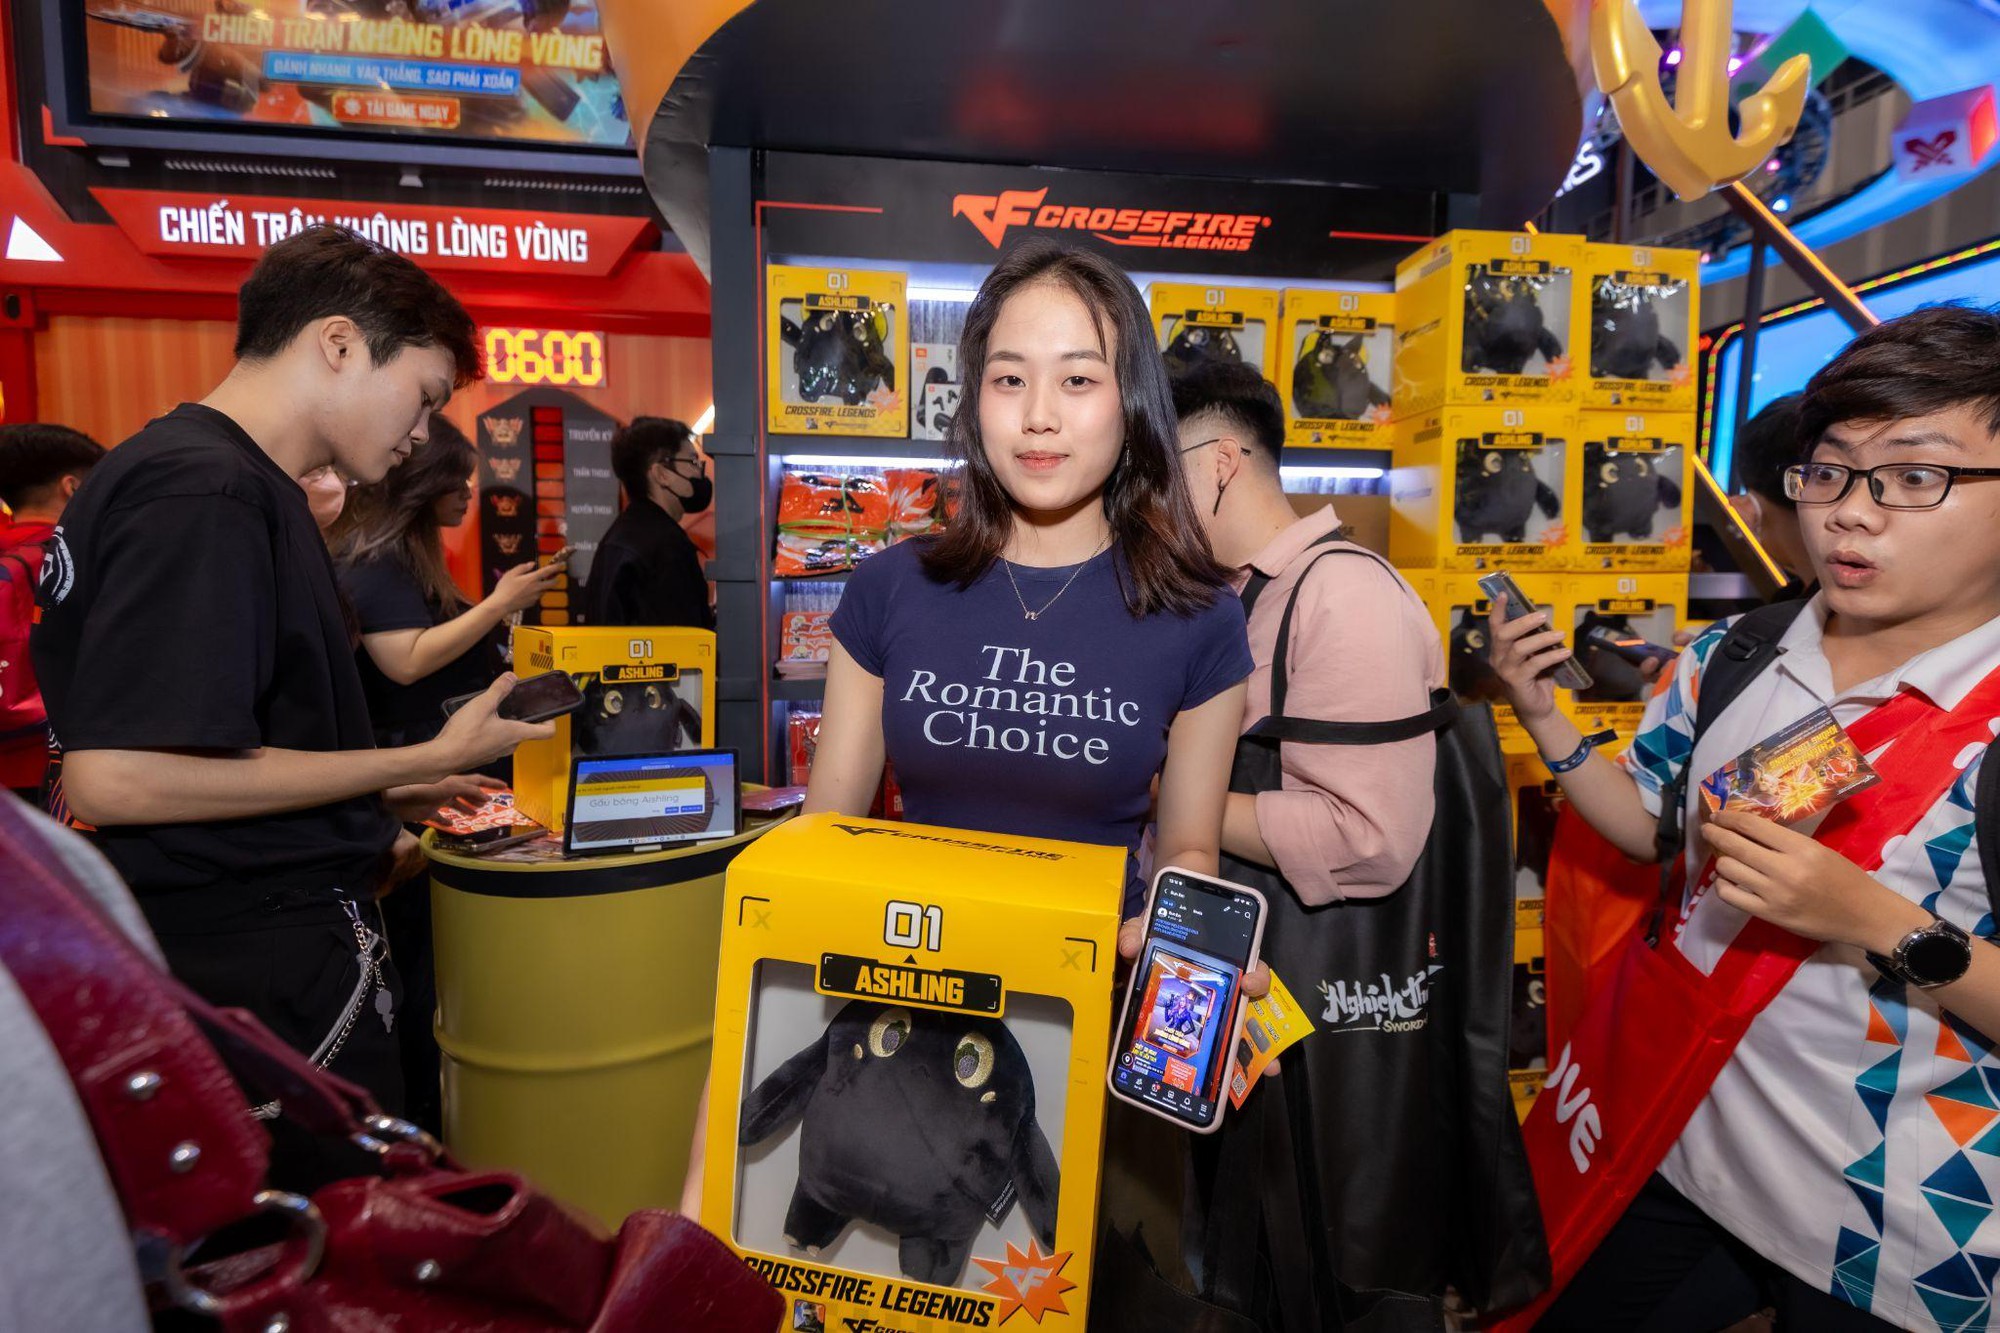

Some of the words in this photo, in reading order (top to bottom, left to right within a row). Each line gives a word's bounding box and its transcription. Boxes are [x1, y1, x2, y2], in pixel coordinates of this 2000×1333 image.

[347, 18, 443, 57] KHÔNG
[451, 22, 520, 64] LÒNG
[532, 28, 602, 68] VÒNG
[419, 104, 449, 120] NGAY
[1034, 205, 1261, 237] CROSSFIRE
[159, 200, 245, 246] CHIẾN
[436, 216, 507, 258] LÒNG
[515, 220, 588, 262] VÒNG
[1160, 234, 1253, 252] LEGENDS
[1511, 237, 1531, 254] 01
[827, 272, 849, 289] 01
[818, 296, 858, 308] ASHLING
[1205, 289, 1225, 306] 01
[1340, 295, 1359, 311] 01
[485, 328, 603, 385] 0600
[837, 407, 877, 418] LEGENDS
[1503, 410, 1523, 426] 01
[1625, 416, 1645, 432] 01
[1618, 578, 1637, 593] 01
[629, 639, 653, 658] 01
[618, 666, 664, 679] ASHLING
[981, 645, 1076, 687] The
[900, 669, 1141, 727] Romantic
[923, 710, 1109, 765] Choice
[893, 832, 1065, 858] CROSSFIRE
[883, 900, 944, 952] 01
[854, 964, 965, 1005] ASHLING
[880, 1284, 995, 1328] LEGENDS
